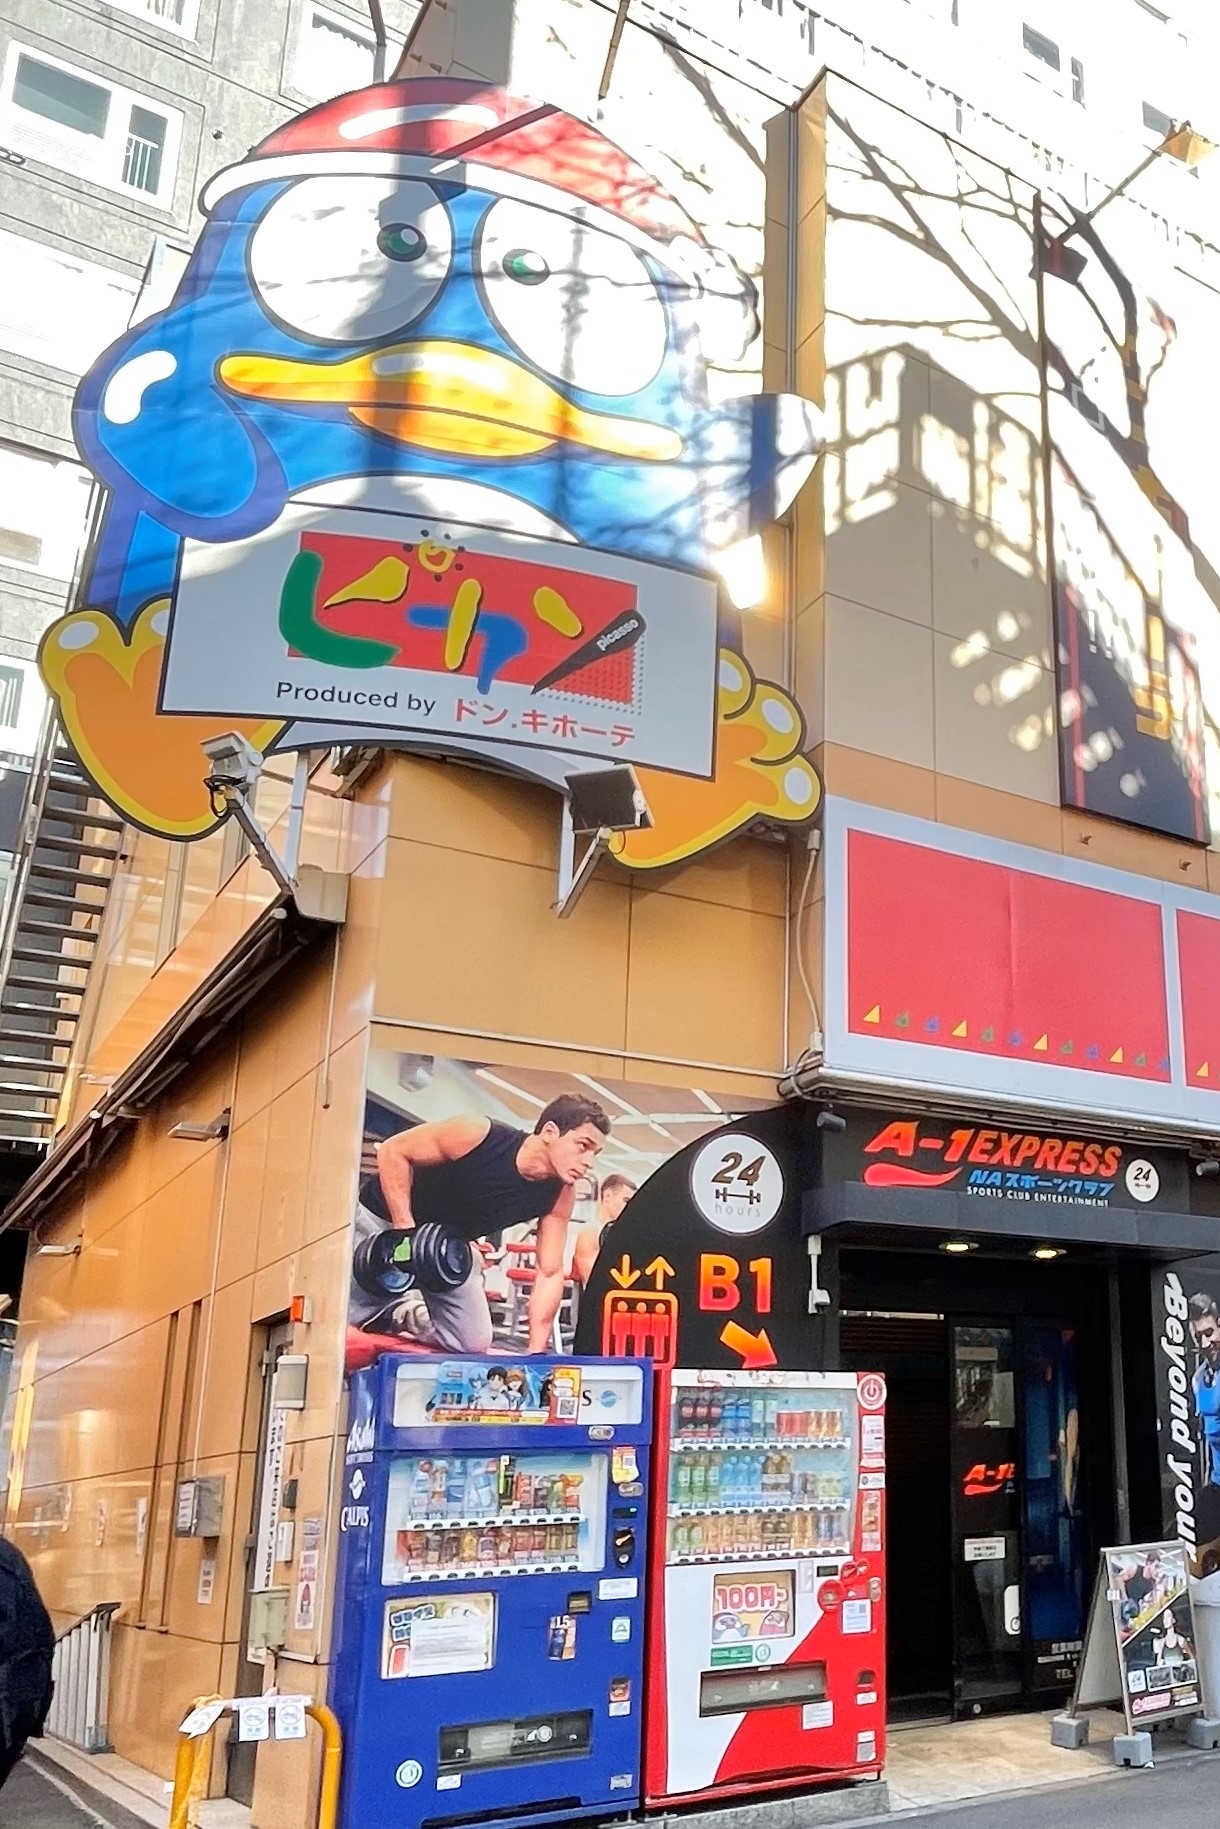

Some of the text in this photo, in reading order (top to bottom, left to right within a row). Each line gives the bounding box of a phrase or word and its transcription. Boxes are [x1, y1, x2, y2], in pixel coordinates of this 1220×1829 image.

[596, 618, 639, 651] picasso
[276, 681, 436, 716] Produced by
[711, 1151, 766, 1186] 24
[1133, 1166, 1152, 1182] 24
[714, 1202, 761, 1217] hours
[967, 1185, 1110, 1208] SPORTS CLUB ENTERTAINMENT
[699, 1253, 772, 1312] B1
[1161, 1272, 1198, 1563] Beyond your
